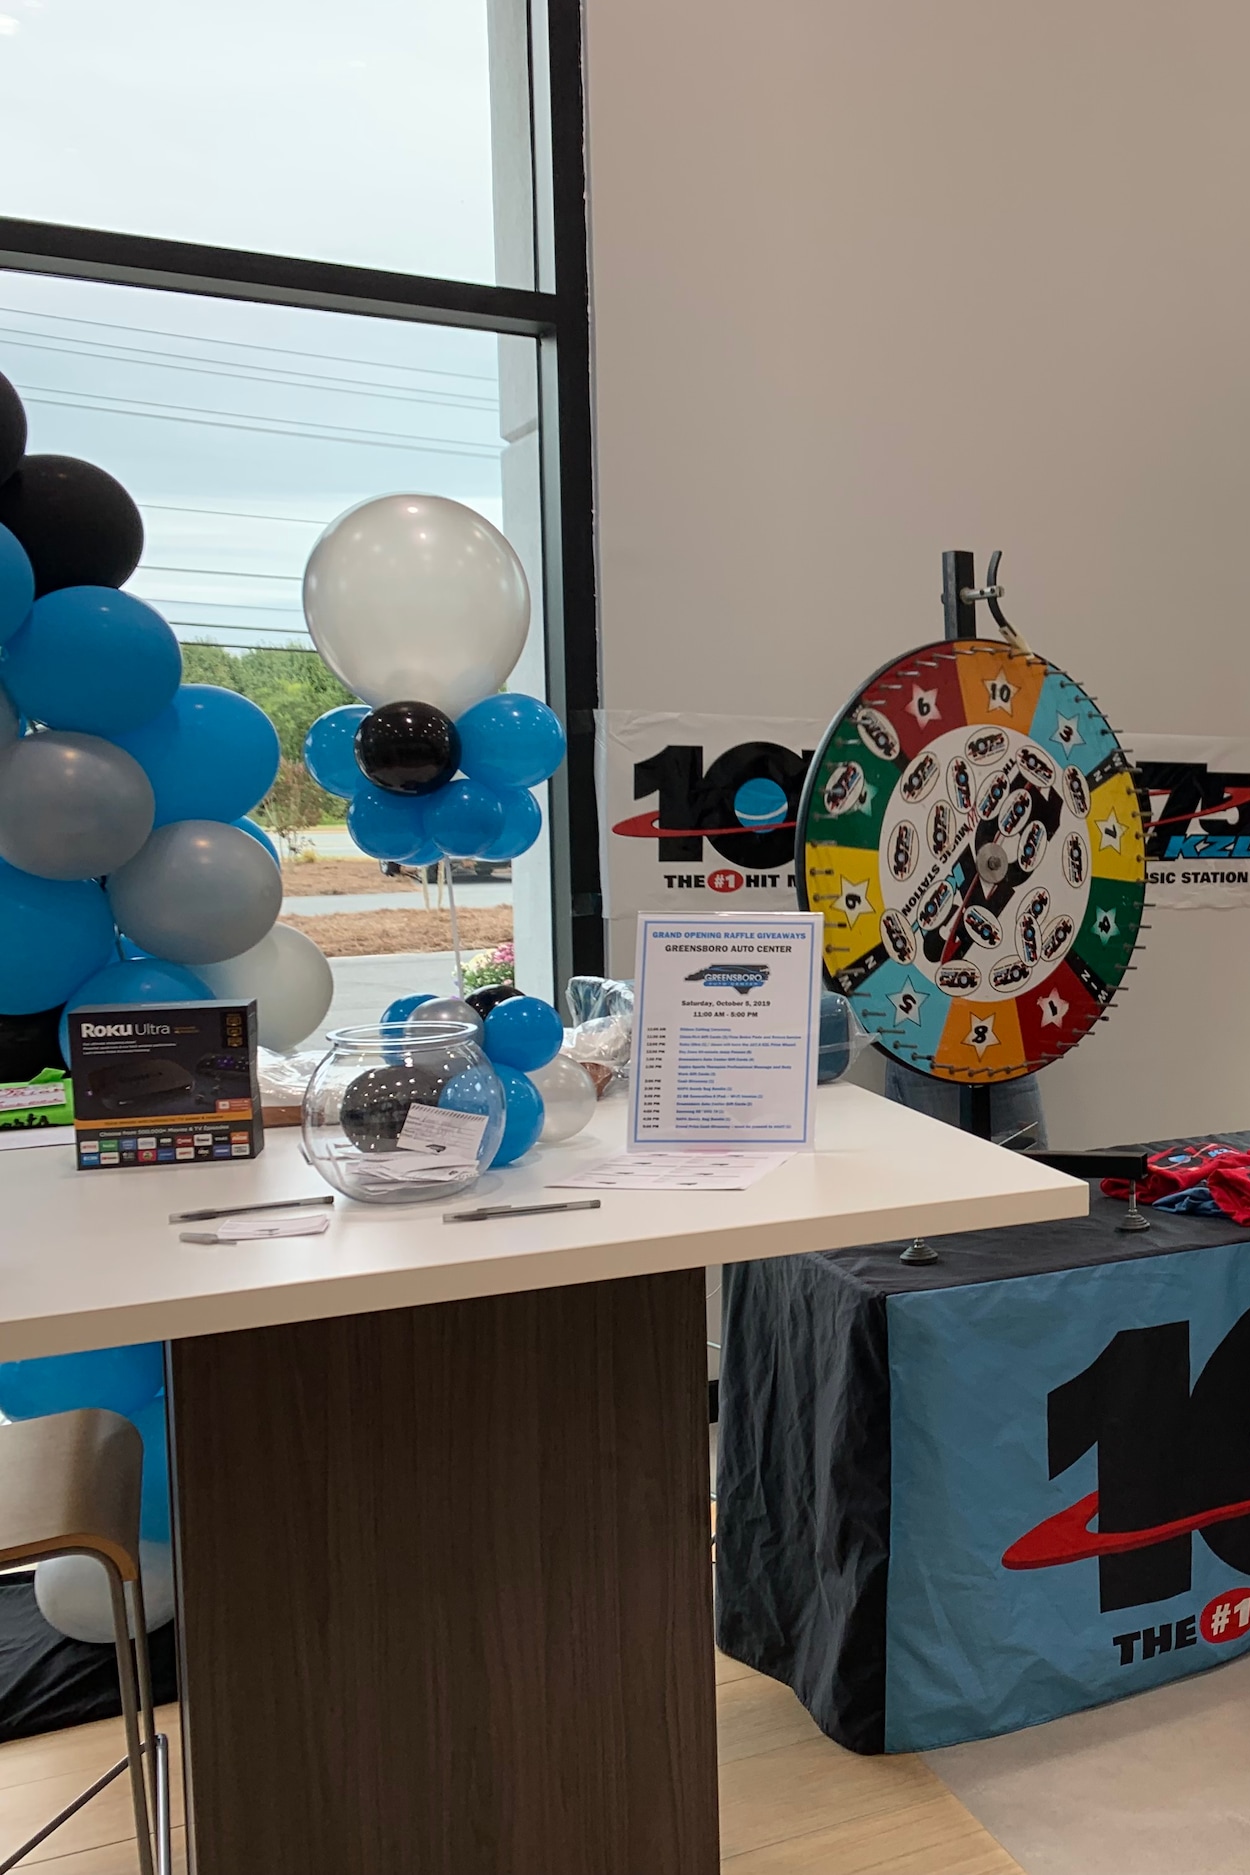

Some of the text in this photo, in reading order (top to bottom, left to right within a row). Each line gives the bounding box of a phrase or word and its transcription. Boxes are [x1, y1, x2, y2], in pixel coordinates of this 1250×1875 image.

[990, 682, 1011, 703] 10
[1060, 725, 1074, 743] 3
[664, 875, 705, 889] THE
[713, 873, 736, 889] #1
[746, 874, 780, 888] HIT
[1181, 871, 1248, 884] STATION
[901, 866, 941, 917] STATION
[652, 931, 682, 939] GRAND
[724, 932, 755, 940] RAFFLE
[756, 932, 806, 940] GIVEAWAYS
[665, 944, 792, 953] GREENSBORO AUTO CENTER
[704, 973, 763, 982] GREENSBORO
[135, 1023, 170, 1036] Ultra
[972, 1025, 989, 1044] 8
[1112, 1614, 1198, 1666] THE
